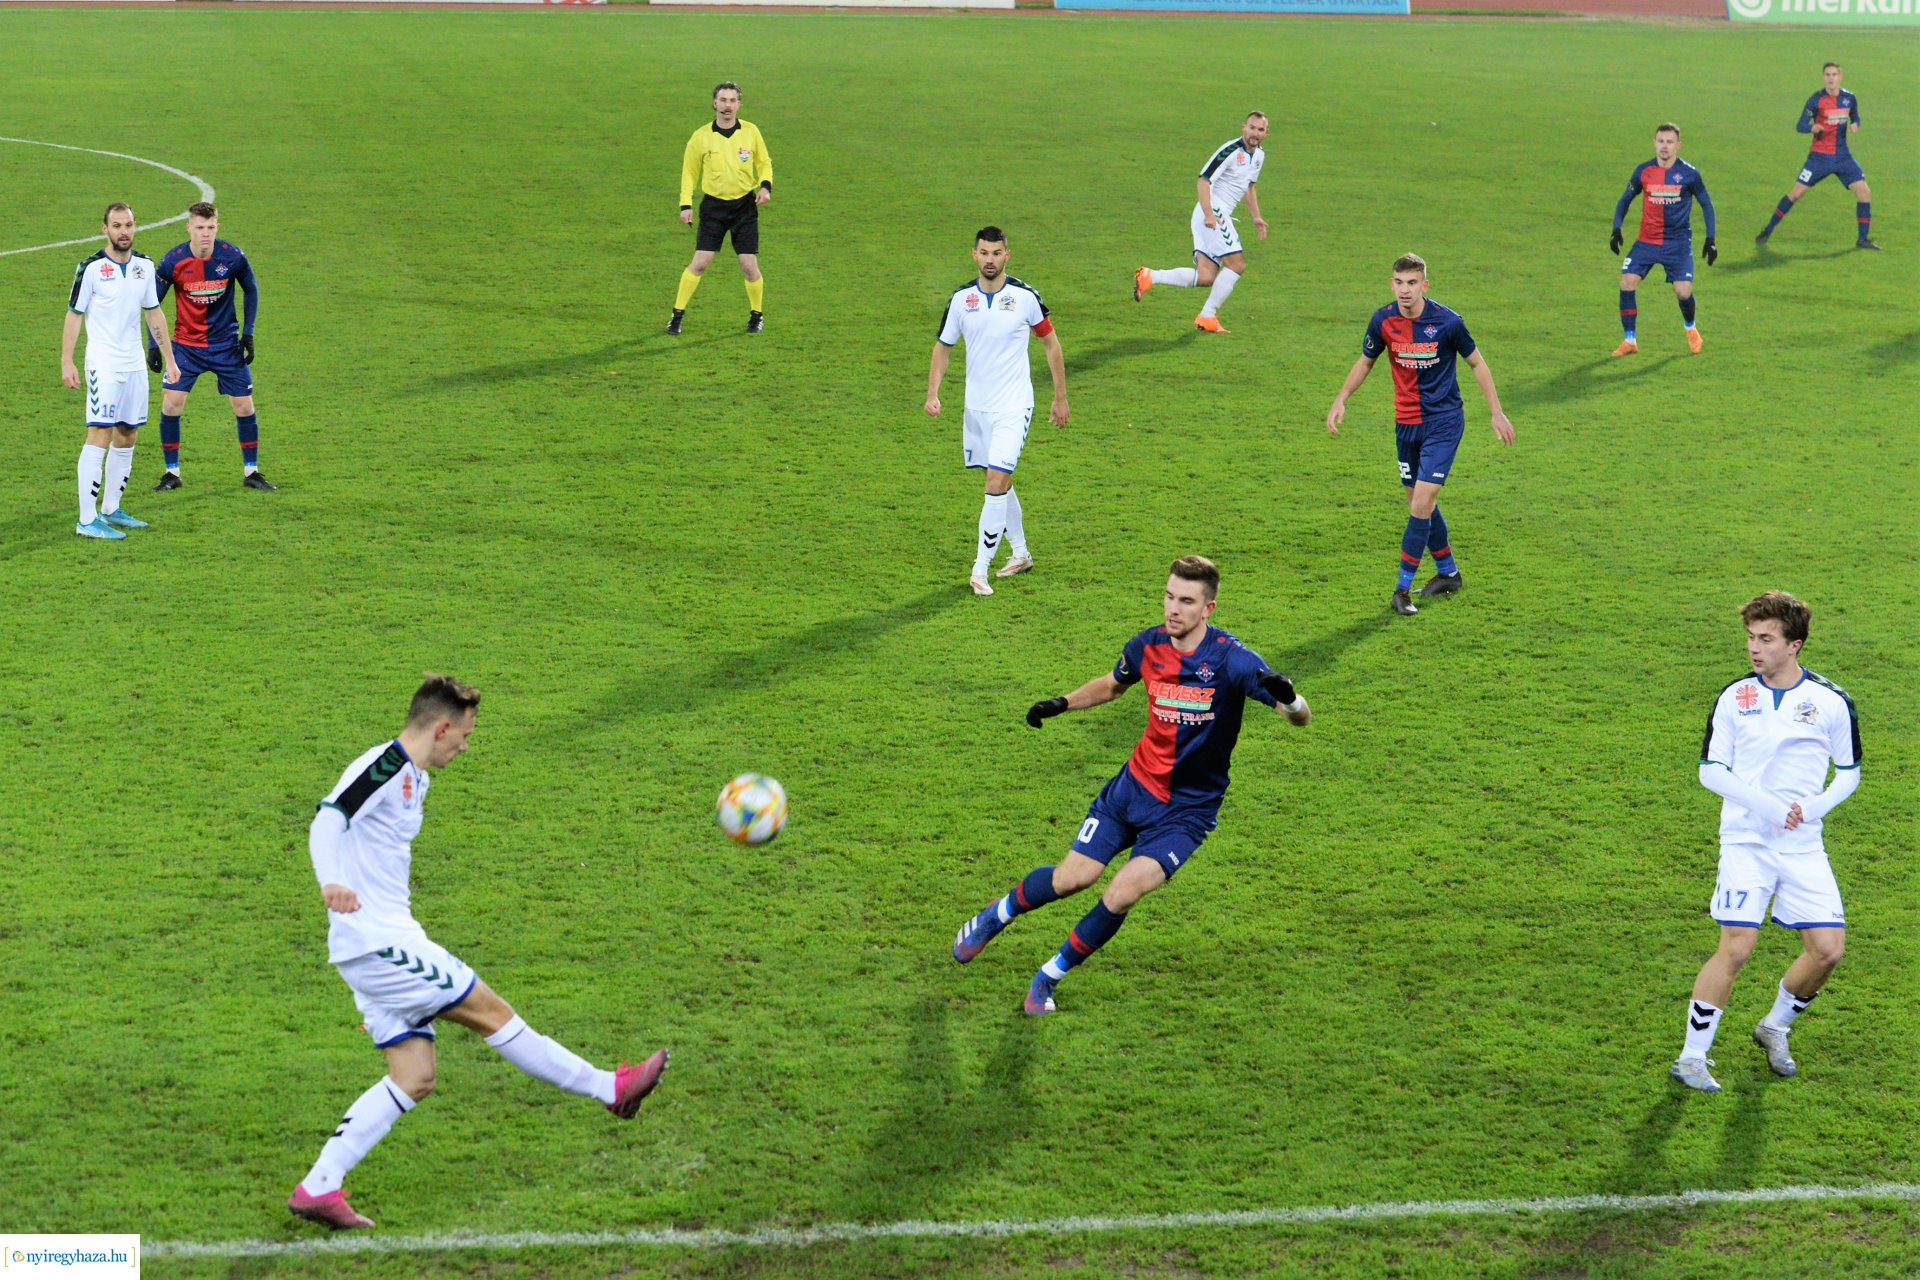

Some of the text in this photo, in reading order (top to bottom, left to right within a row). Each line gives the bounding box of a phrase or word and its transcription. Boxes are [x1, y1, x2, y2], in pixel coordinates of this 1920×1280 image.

[102, 404, 115, 418] 16
[1148, 681, 1215, 703] REVESZ
[1725, 890, 1748, 909] 17
